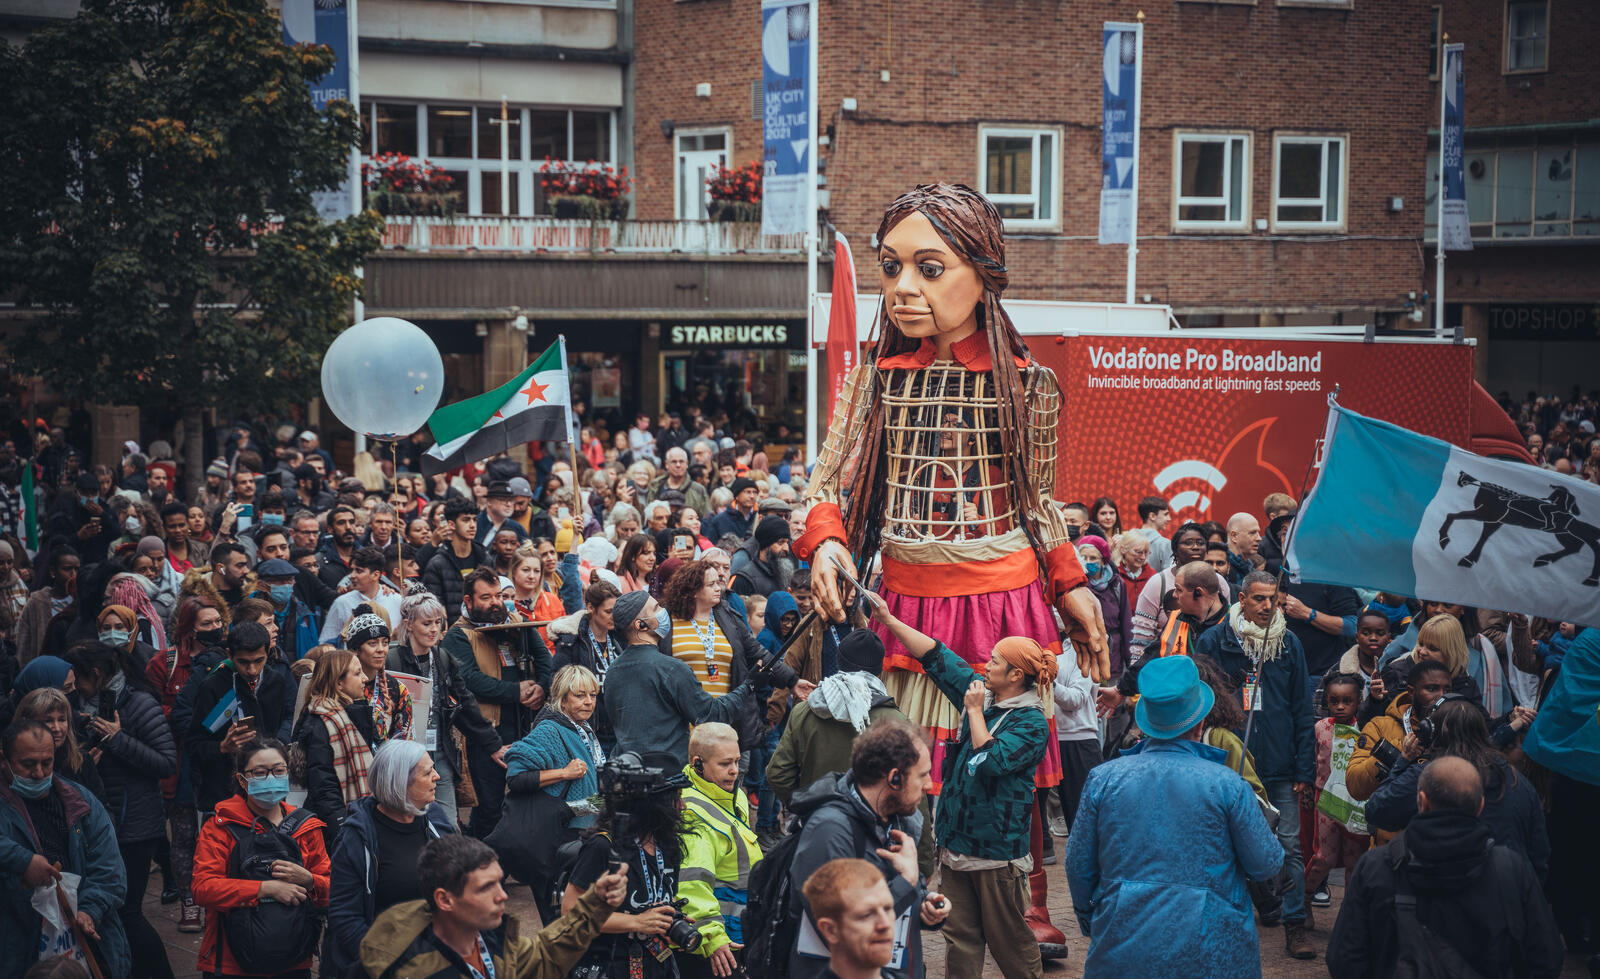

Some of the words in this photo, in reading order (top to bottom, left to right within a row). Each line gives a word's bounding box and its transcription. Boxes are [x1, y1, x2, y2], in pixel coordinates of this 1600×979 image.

[766, 92, 781, 103] UK
[782, 90, 804, 103] CITY
[766, 103, 781, 116] OF
[766, 127, 791, 140] 2021
[1490, 308, 1586, 329] TOPSHOP
[672, 325, 787, 343] STARBUCKS
[1088, 346, 1181, 370] Vodafone
[1186, 348, 1217, 371] Pro
[1222, 350, 1321, 372] Broadband
[1088, 374, 1140, 389] Invincible
[1143, 375, 1200, 390] broadband
[1203, 378, 1213, 391] at
[1215, 377, 1262, 393] lightning
[1264, 377, 1283, 391] fast
[1285, 378, 1321, 393] speeds
